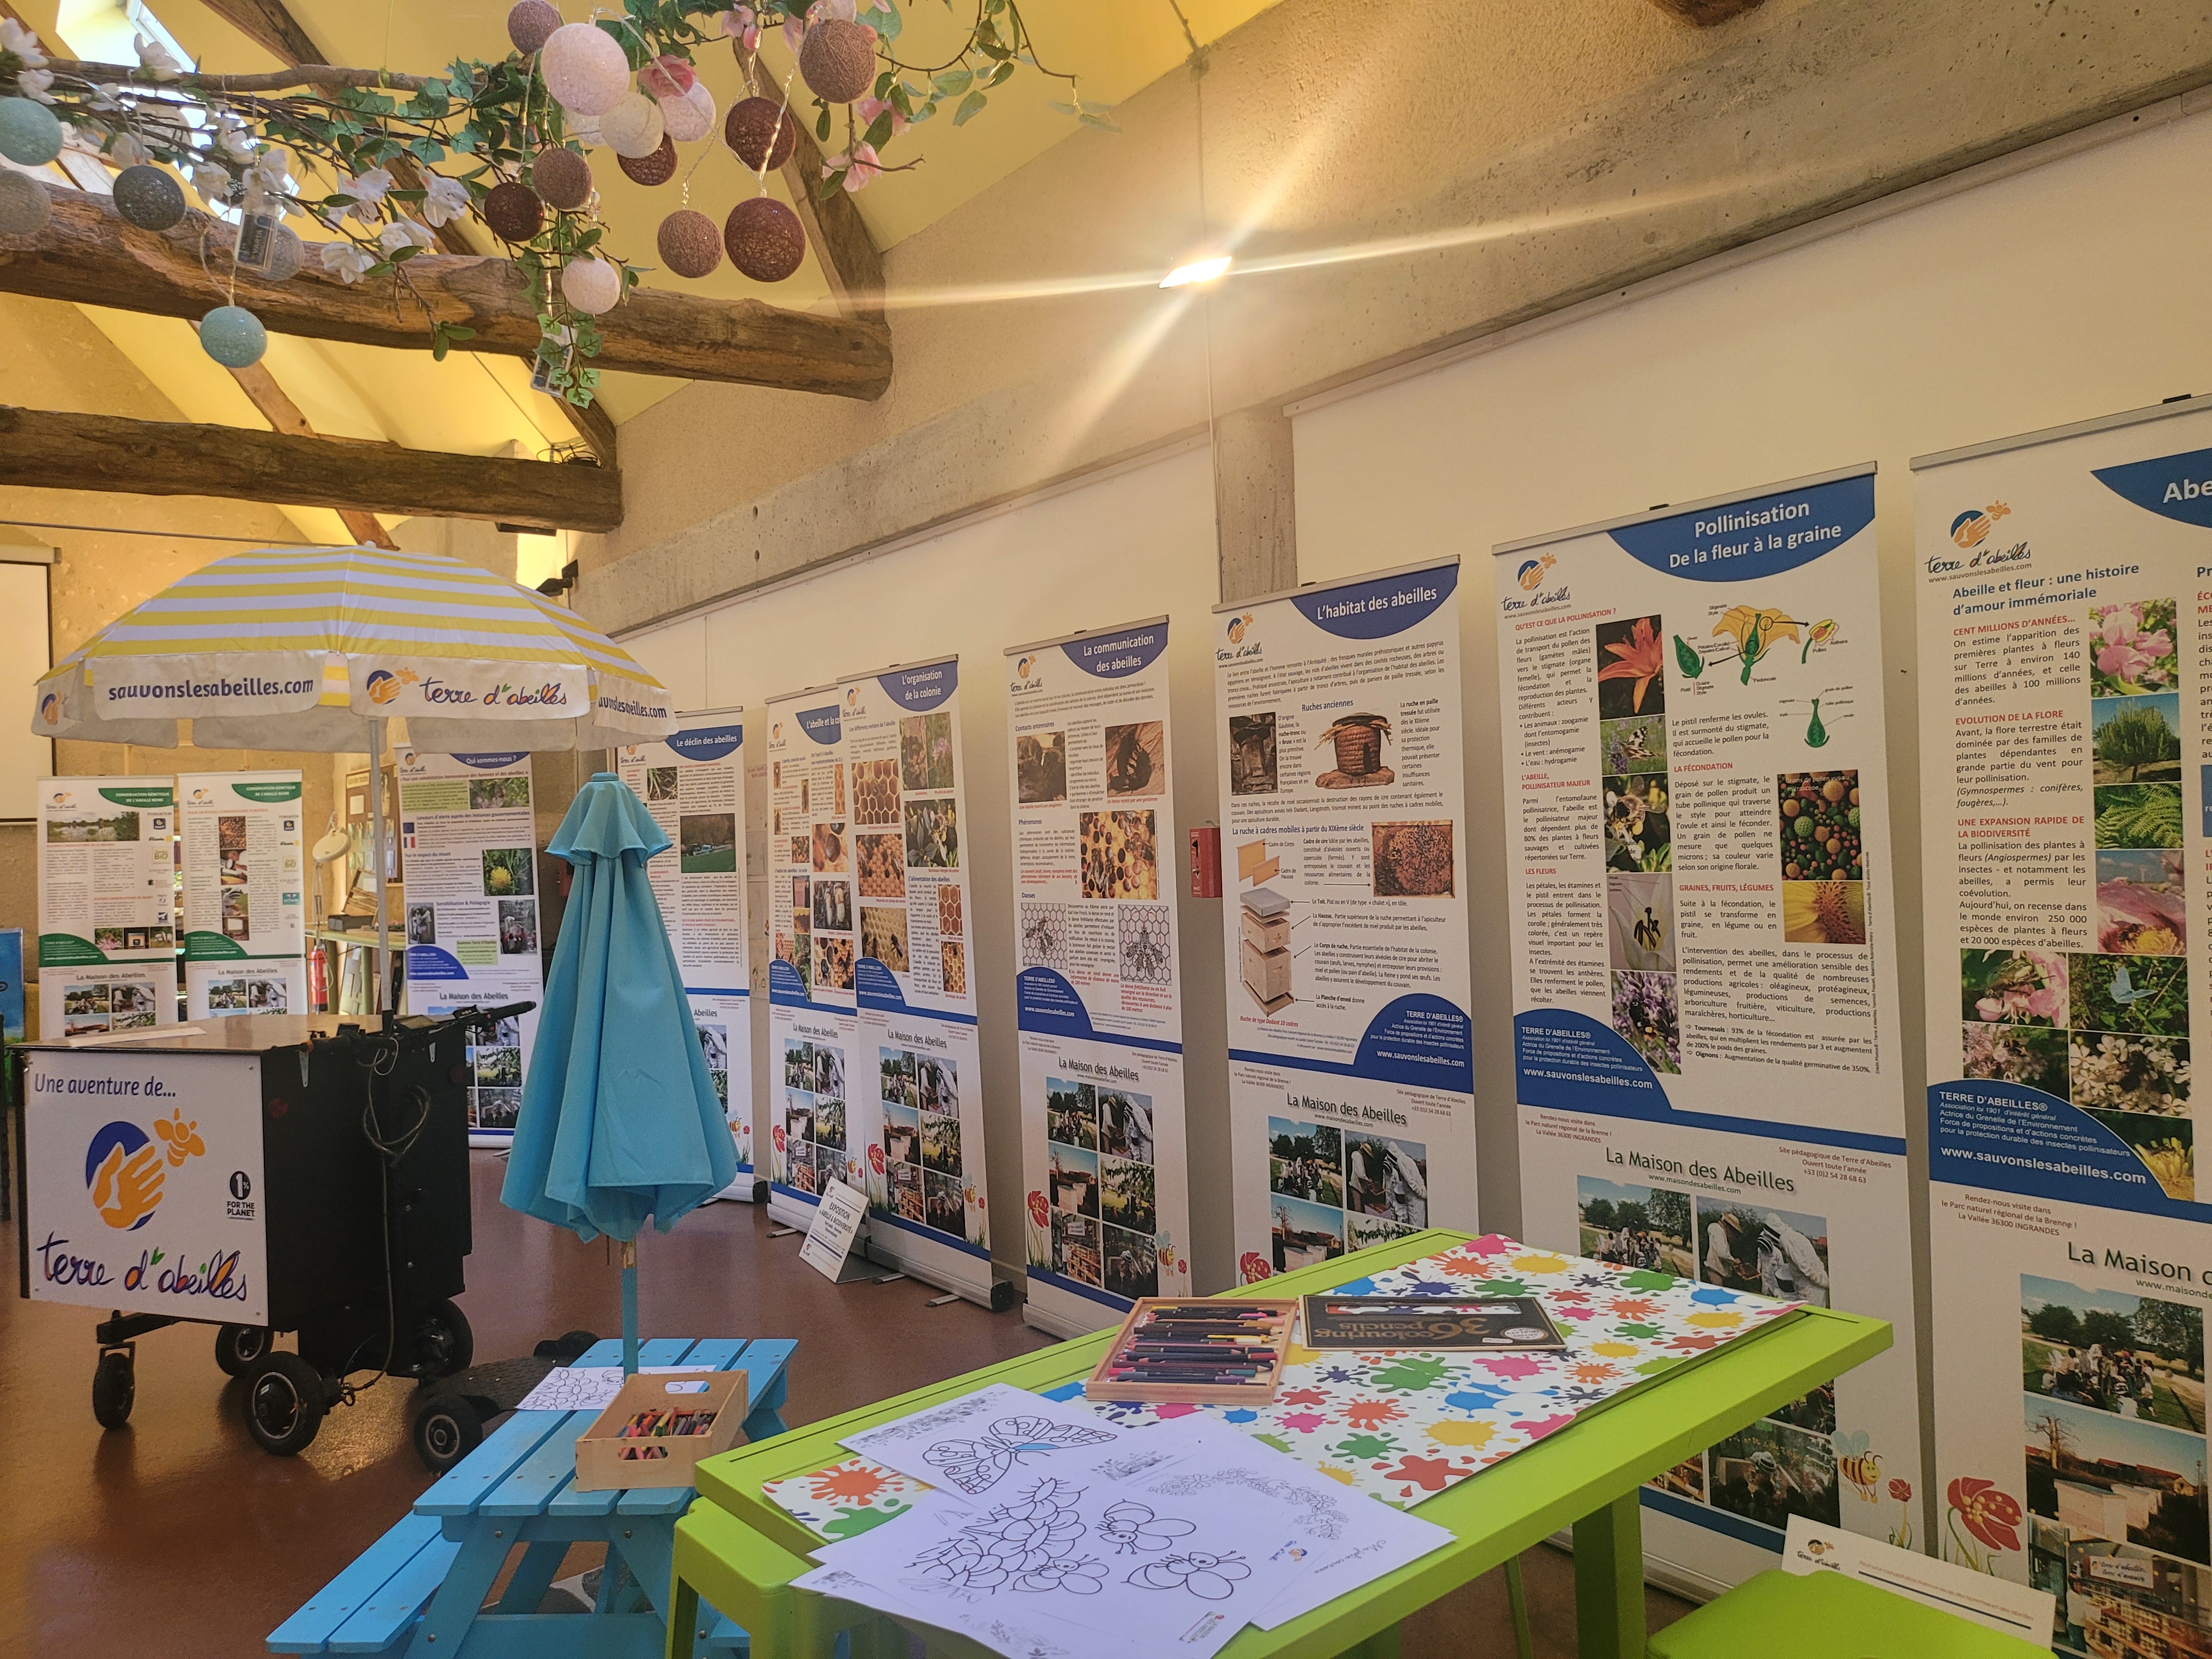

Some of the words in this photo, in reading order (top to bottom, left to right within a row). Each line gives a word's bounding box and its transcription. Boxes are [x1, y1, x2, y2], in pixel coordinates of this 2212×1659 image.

[1695, 503, 1809, 538] Pollinisation
[1669, 552, 1690, 568] De
[1694, 549, 1707, 563] la
[1711, 543, 1750, 560] fleur
[1768, 534, 1782, 550] la
[1787, 526, 1842, 550] graine
[1924, 555, 1965, 574] terre
[1969, 541, 2031, 568] d'abeilles
[1928, 563, 2032, 583] www.sauvonslesabeilles.com
[1953, 584, 1995, 599] Abeille
[1999, 582, 2011, 592] et
[2014, 578, 2045, 590] fleur
[2057, 573, 2081, 584] une
[2086, 564, 2139, 580] histoire
[1317, 600, 1366, 620] L'habitat
[1368, 595, 1389, 611] des
[1391, 587, 1437, 607] abeilles
[1501, 596, 1528, 611] terre
[1530, 586, 1571, 607] d'abeilles
[1953, 601, 2005, 616] d'amour
[2008, 588, 2097, 608] immémoriale
[1515, 622, 1536, 631] QU'EST
[1544, 618, 1558, 626] QUE
[1566, 609, 1611, 622] POLLINISATION
[1953, 627, 1976, 636] CENT
[1978, 621, 2019, 633] MILLIONS
[1084, 645, 1092, 657] La
[1093, 635, 1154, 654] communication
[1972, 637, 2000, 646] estime
[2007, 630, 2057, 642] l'apparition
[2063, 627, 2080, 635] des
[1096, 661, 1110, 673] des
[1111, 655, 1142, 670] abeilles
[902, 669, 943, 685] L'organisation
[109, 677, 314, 701] sauvonslesabeilles.com
[419, 676, 478, 702] terre
[483, 682, 567, 706] d'abeilles
[905, 690, 913, 701] de
[913, 689, 919, 699] la
[919, 685, 941, 698] colonie
[1302, 702, 1322, 712] Ruches
[1323, 699, 1353, 709] anciennes
[824, 718, 830, 726] et
[830, 716, 834, 725] la
[1955, 714, 2005, 725] EVOLUTION
[2008, 713, 2019, 721] DE
[2035, 710, 2063, 719] FLORE
[684, 737, 702, 746] déclin
[703, 736, 714, 744] des
[714, 734, 737, 744] abeilles
[1684, 762, 1733, 772] FÉCONDATION
[1522, 781, 1565, 790] POLLINISATEUR
[1239, 827, 1255, 835] ruche
[1260, 826, 1278, 834] cadres
[1278, 825, 1301, 833] mobiles
[1306, 825, 1320, 834] partir
[1348, 823, 1364, 832] siècle
[1979, 817, 2030, 826] EXPANSION
[2034, 816, 2068, 825] RAPIDE
[2072, 816, 2084, 824] DE
[1971, 827, 2030, 838] BIODIVERSITÉ
[1740, 883, 1774, 891] LÉGUMES
[1971, 936, 1982, 944] 20
[1983, 936, 2000, 945] 000
[2001, 938, 2036, 947] espèces
[2038, 938, 2084, 948] d'abeilles.
[1406, 1010, 1425, 1019] TERRE
[888, 1029, 894, 1039] La
[895, 1030, 913, 1042] Maison
[913, 1033, 923, 1044] des
[924, 1035, 947, 1048] Abeilles
[1521, 1026, 1544, 1035] TERRE
[1058, 1056, 1067, 1070] La
[1068, 1058, 1093, 1074] Maison
[1094, 1062, 1107, 1075] des
[1109, 1065, 1139, 1081] Abeilles
[1376, 1050, 1465, 1068] www.sauvonslesabeilles.com
[35, 1073, 64, 1093] Une
[68, 1076, 140, 1096] aventure
[1523, 1068, 1653, 1089] www.sauvonslesabeilles.com
[1939, 1091, 1974, 1103] TERRE
[1287, 1092, 1299, 1107] La
[1301, 1095, 1336, 1113] Maison
[1340, 1101, 1358, 1116] des
[1361, 1105, 1407, 1125] Abeilles
[1606, 1147, 1624, 1165] La
[1629, 1150, 1683, 1174] Maison
[1689, 1160, 1717, 1179] des
[1723, 1165, 1795, 1192] Abeilles
[1816, 1170, 1829, 1178] (0)2
[1940, 1147, 2146, 1184] www.sauvonslesabeilles.com
[1648, 1174, 1741, 1195] www.maisondesabeilles.com
[227, 1208, 255, 1217] PLANET
[829, 1202, 851, 1221] EXPOSITION
[37, 1231, 116, 1286] terre
[125, 1246, 247, 1302] d'abeilles
[2068, 1242, 2095, 1265] La
[2104, 1248, 2191, 1282] Maison
[1314, 1328, 1435, 1340] colouring
[1339, 1320, 1424, 1331] pencils
[1428, 1317, 1491, 1340] 36
